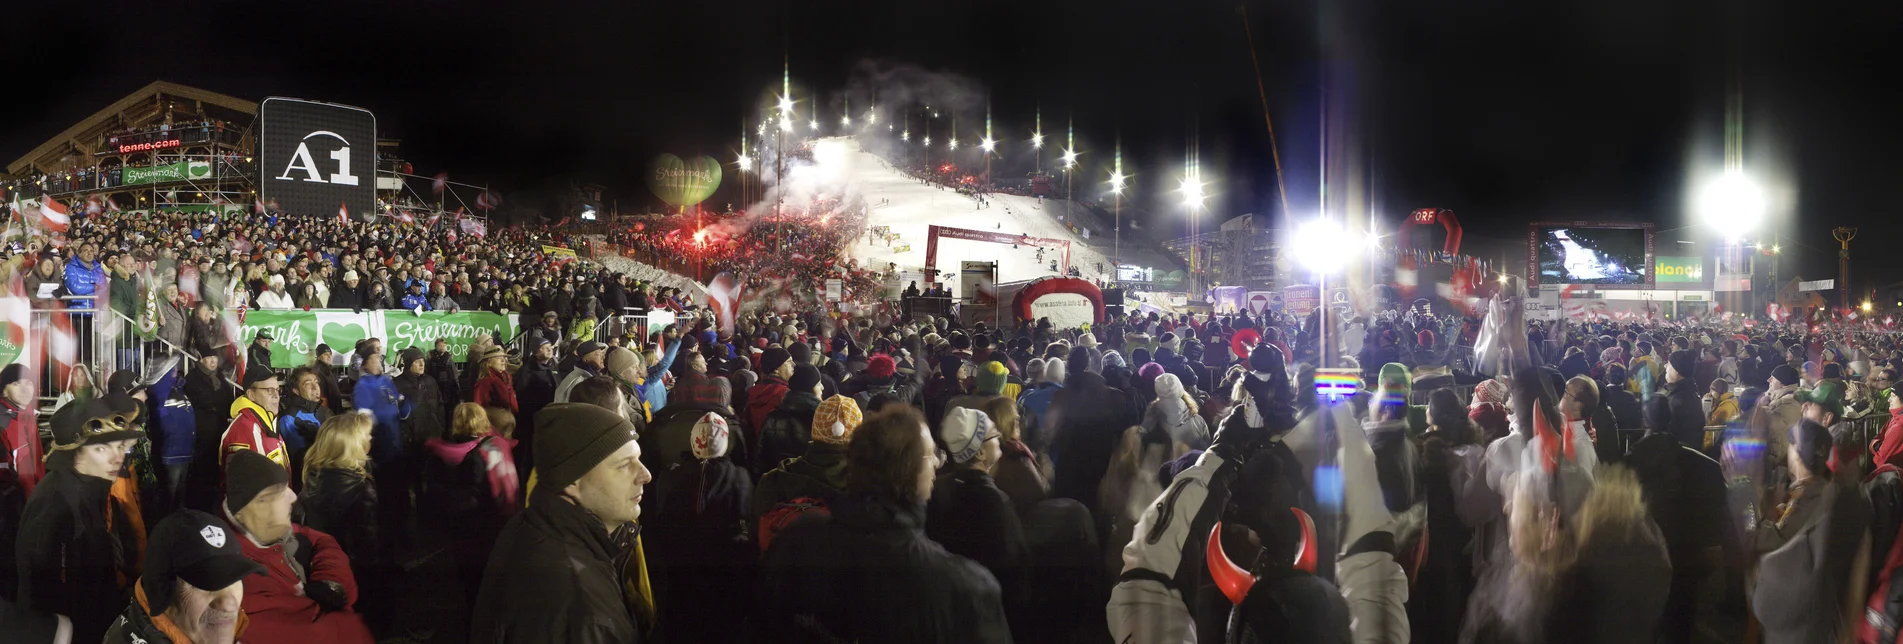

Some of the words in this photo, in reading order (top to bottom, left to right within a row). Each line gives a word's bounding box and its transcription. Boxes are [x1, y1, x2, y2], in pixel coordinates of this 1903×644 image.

[120, 139, 180, 153] tenne.com
[276, 142, 358, 186] A1
[656, 167, 713, 183] Steiermark
[1415, 211, 1434, 221] ORF
[446, 343, 469, 357] POR
